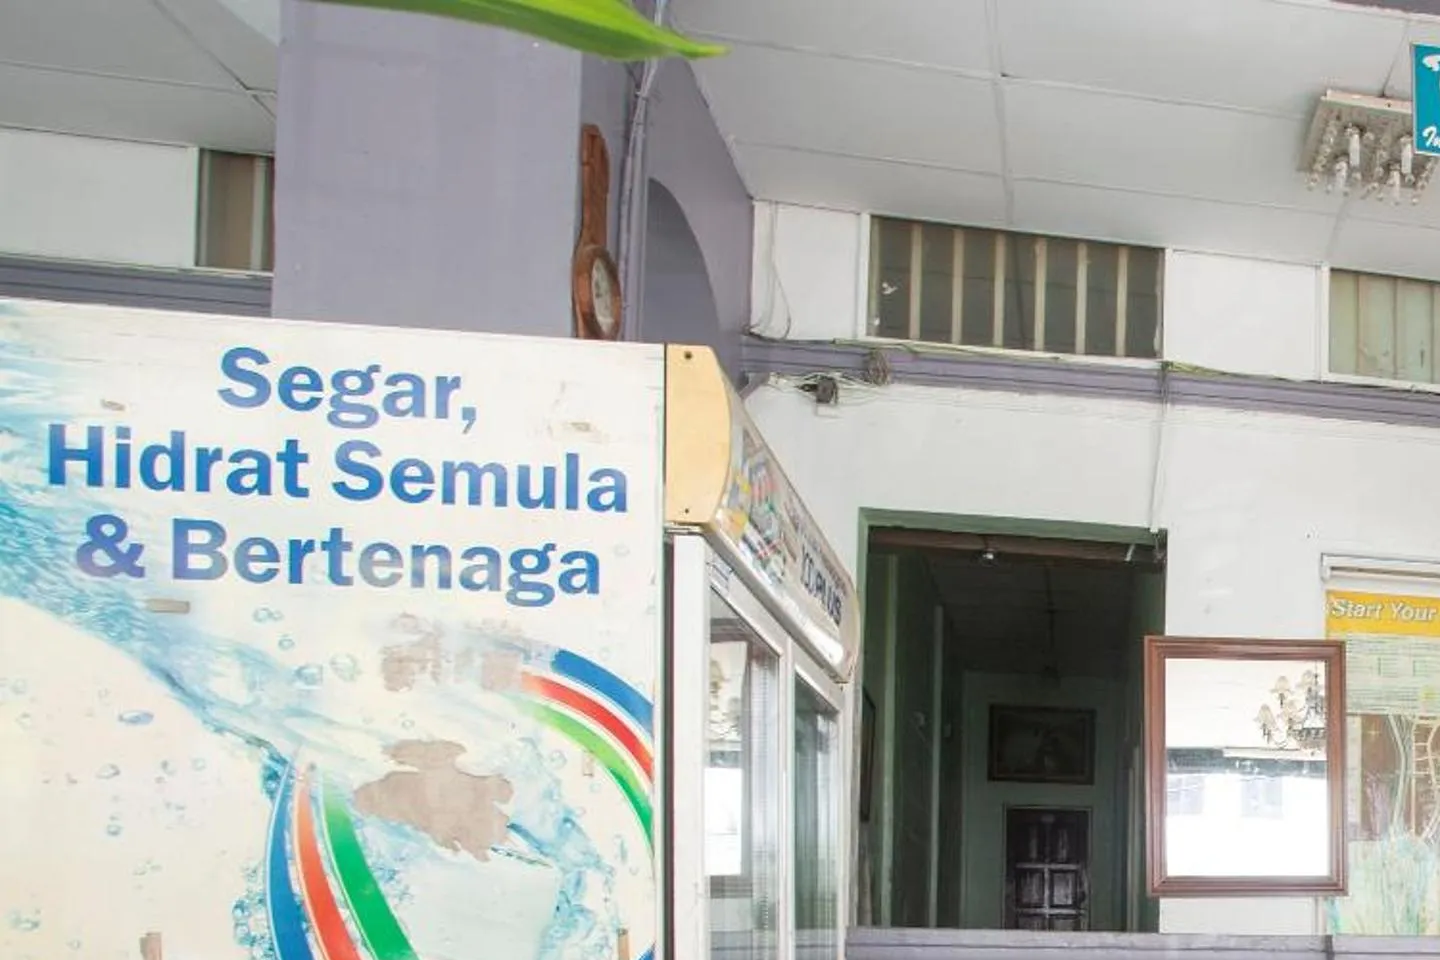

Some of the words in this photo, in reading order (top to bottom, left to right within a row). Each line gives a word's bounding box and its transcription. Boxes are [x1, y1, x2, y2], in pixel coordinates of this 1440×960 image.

[217, 347, 478, 434] Segar,
[48, 423, 309, 498] Hidrat
[331, 440, 629, 514] Semula
[75, 513, 146, 579] &
[171, 517, 601, 608] Bertenaga
[1331, 598, 1384, 620] Start
[1391, 602, 1437, 622] Your
